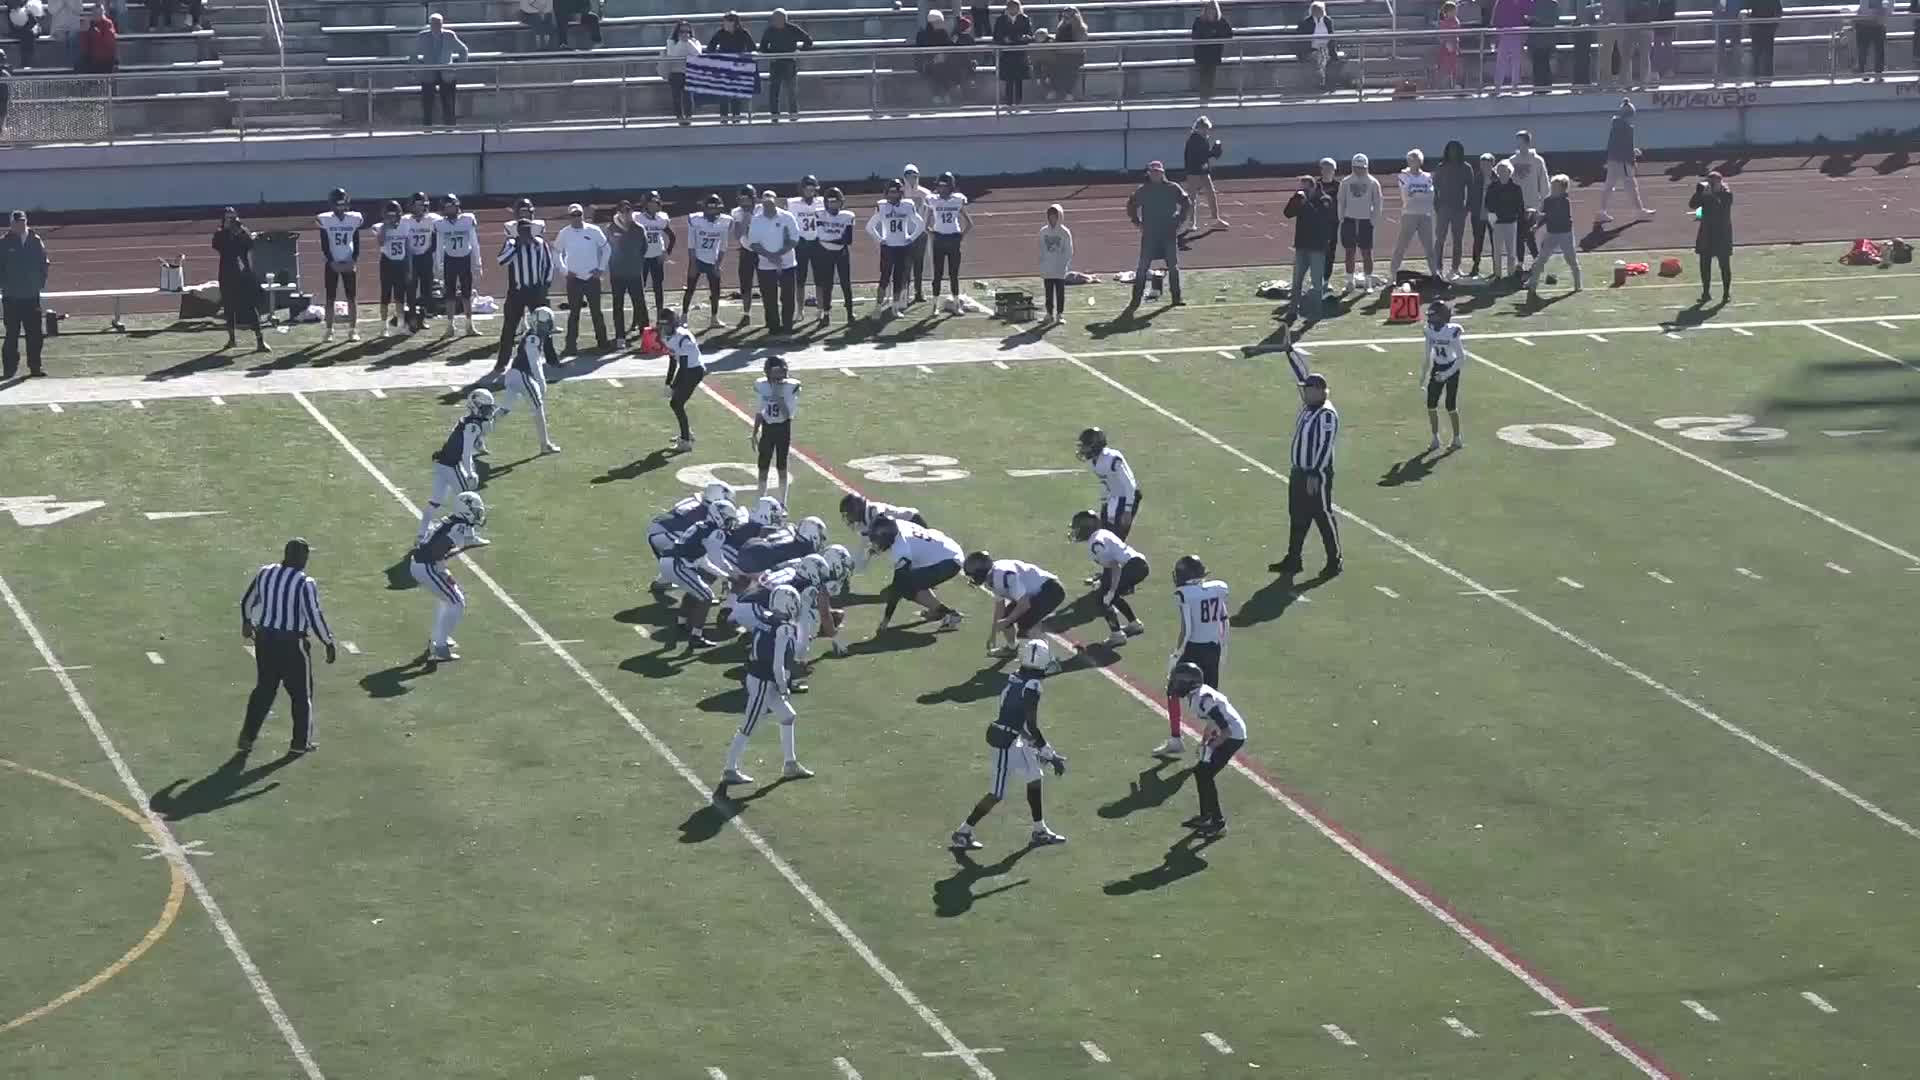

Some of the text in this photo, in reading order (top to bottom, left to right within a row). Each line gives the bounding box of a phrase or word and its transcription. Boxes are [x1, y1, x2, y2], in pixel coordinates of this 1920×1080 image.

[941, 212, 953, 223] 12
[802, 218, 816, 231] 34
[335, 232, 348, 245] 54
[702, 238, 716, 249] 27
[1394, 294, 1420, 319] 20
[1200, 597, 1219, 624] 87
